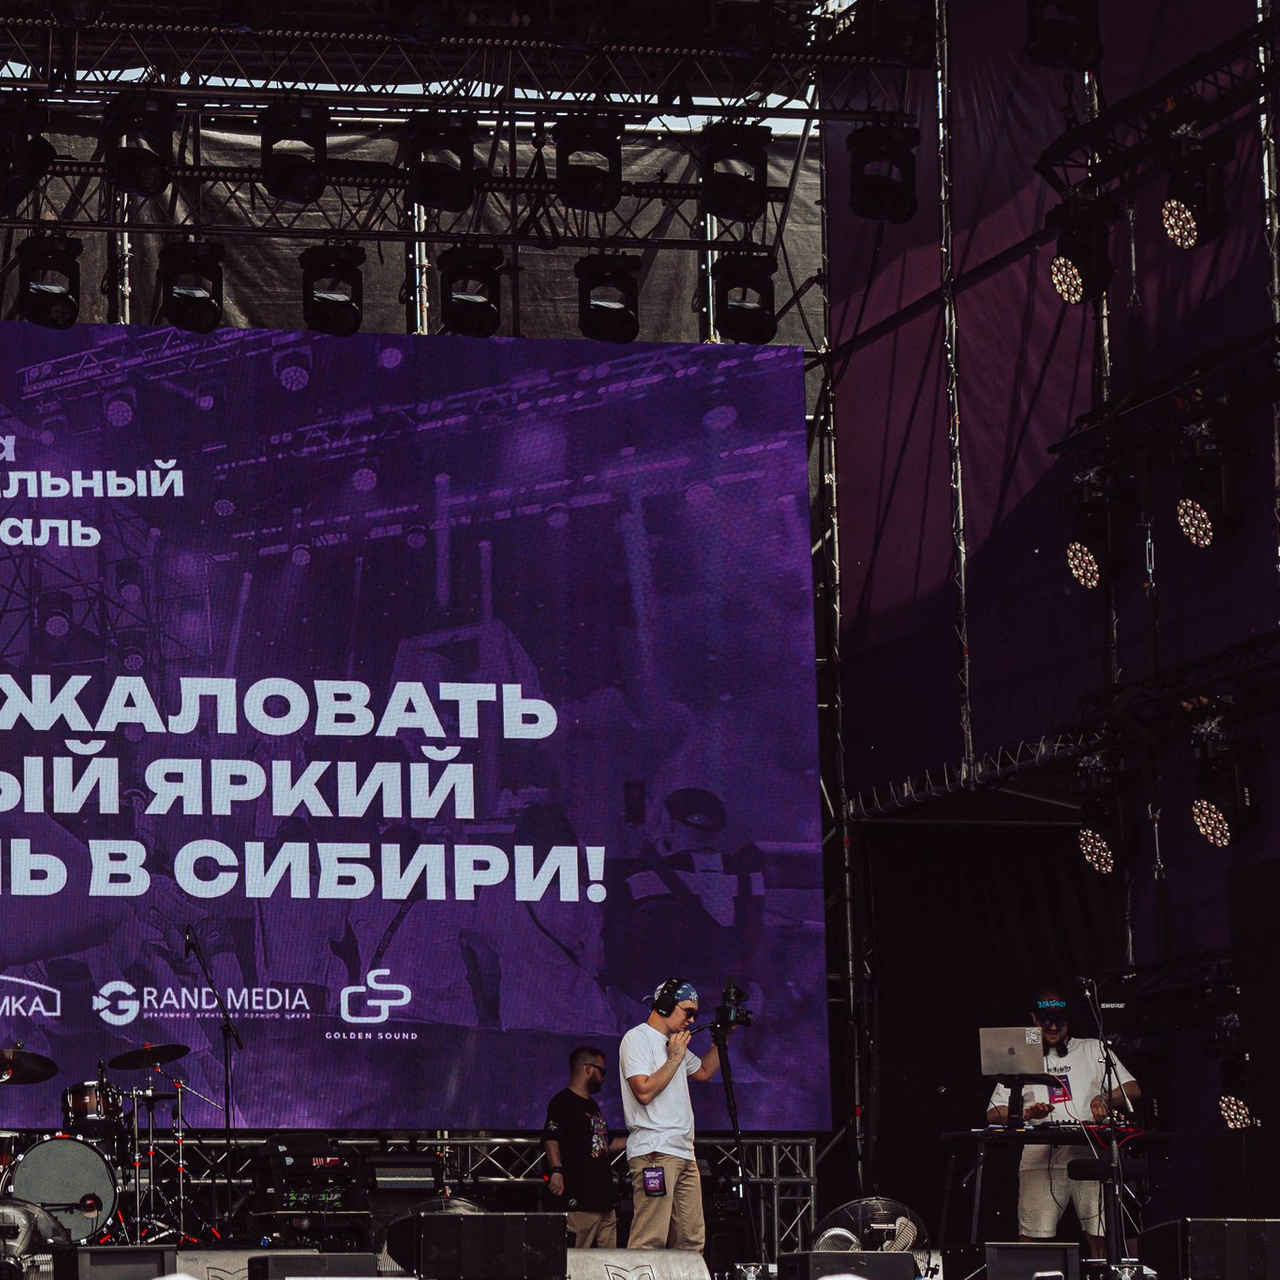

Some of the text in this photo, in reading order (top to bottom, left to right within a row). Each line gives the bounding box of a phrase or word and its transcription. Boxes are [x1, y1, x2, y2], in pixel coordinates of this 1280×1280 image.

[143, 745, 476, 820] ЯРКИЙ
[87, 838, 152, 898] В
[173, 838, 608, 904] СИБИРИ!
[226, 986, 311, 1010] MEDIA
[324, 1031, 419, 1041] GOLDEN SOUND
